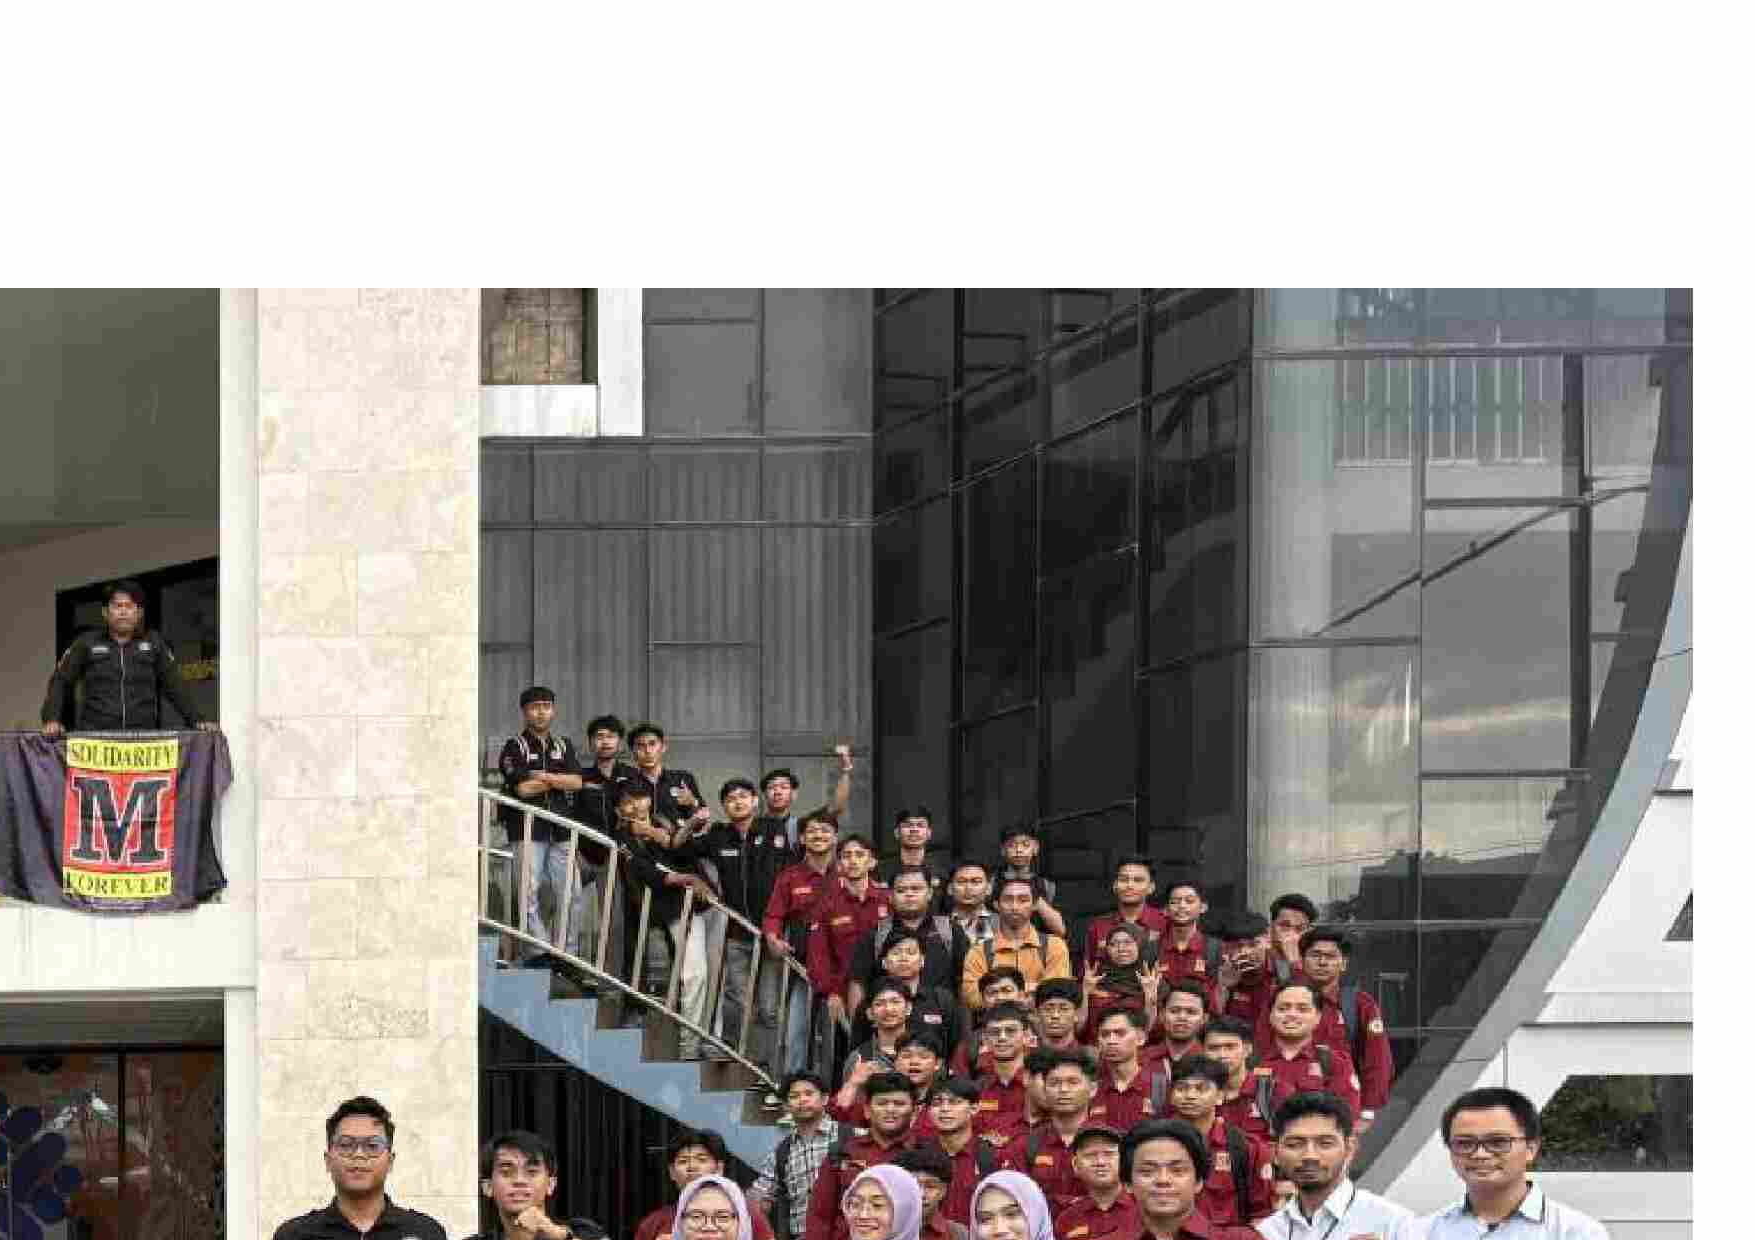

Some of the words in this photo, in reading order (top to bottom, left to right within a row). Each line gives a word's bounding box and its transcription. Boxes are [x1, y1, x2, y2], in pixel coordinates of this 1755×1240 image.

[70, 742, 176, 768] SOLIDARITY
[70, 774, 171, 866] M
[64, 872, 168, 895] FOREVER
